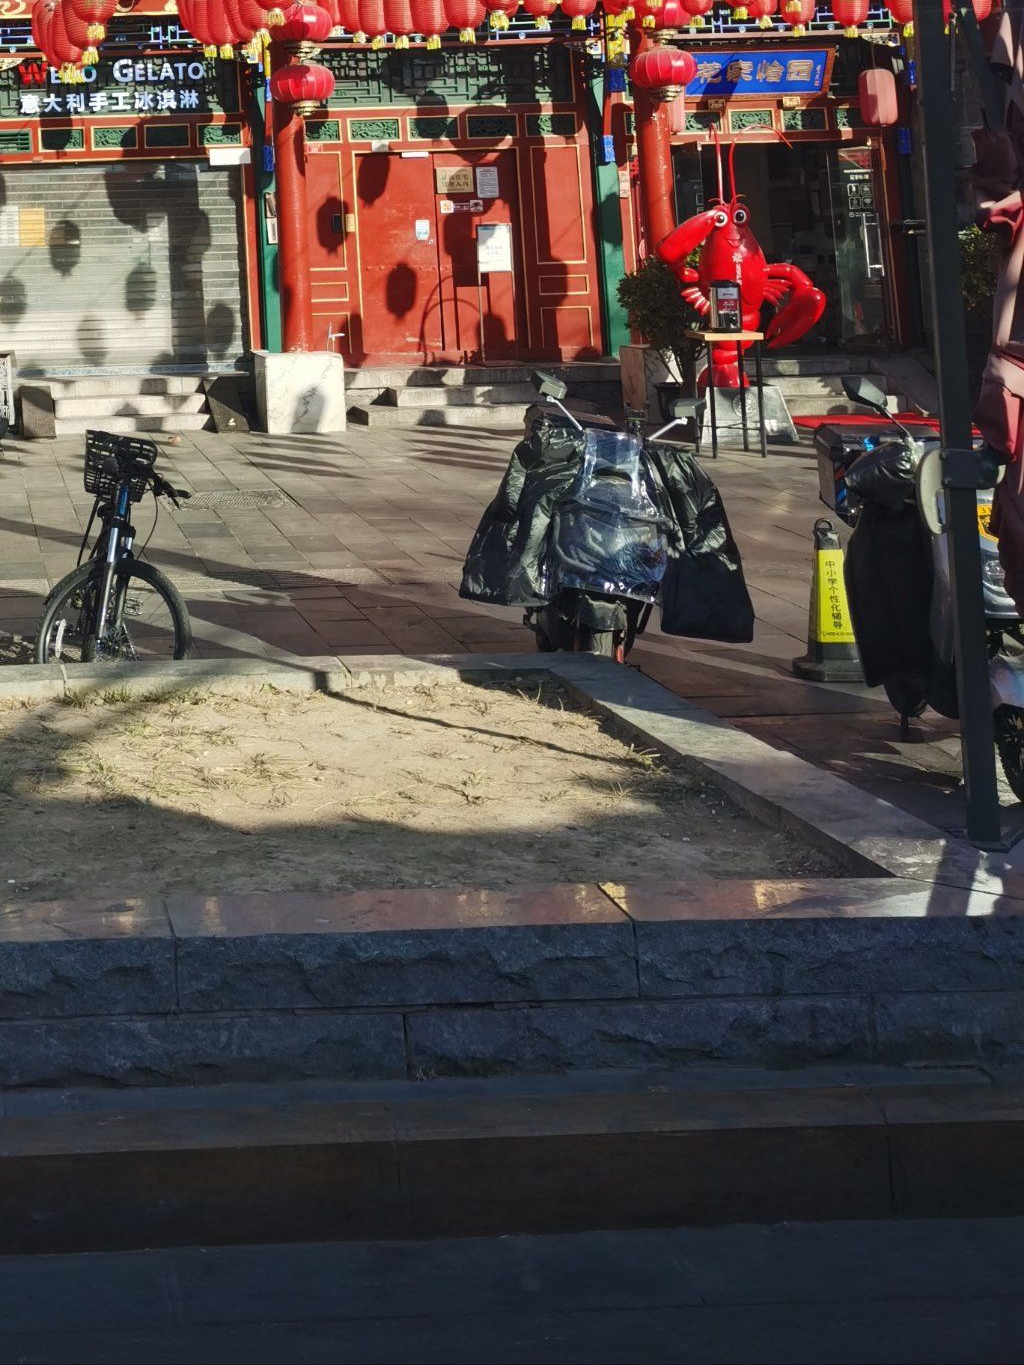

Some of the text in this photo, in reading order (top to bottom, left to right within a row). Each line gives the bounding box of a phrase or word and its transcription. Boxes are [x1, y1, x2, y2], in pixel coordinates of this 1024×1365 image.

[113, 58, 206, 82] GELATO
[19, 89, 200, 114] 意大利手工冰淇淋
[825, 560, 843, 630] 中小学个性化辅导
